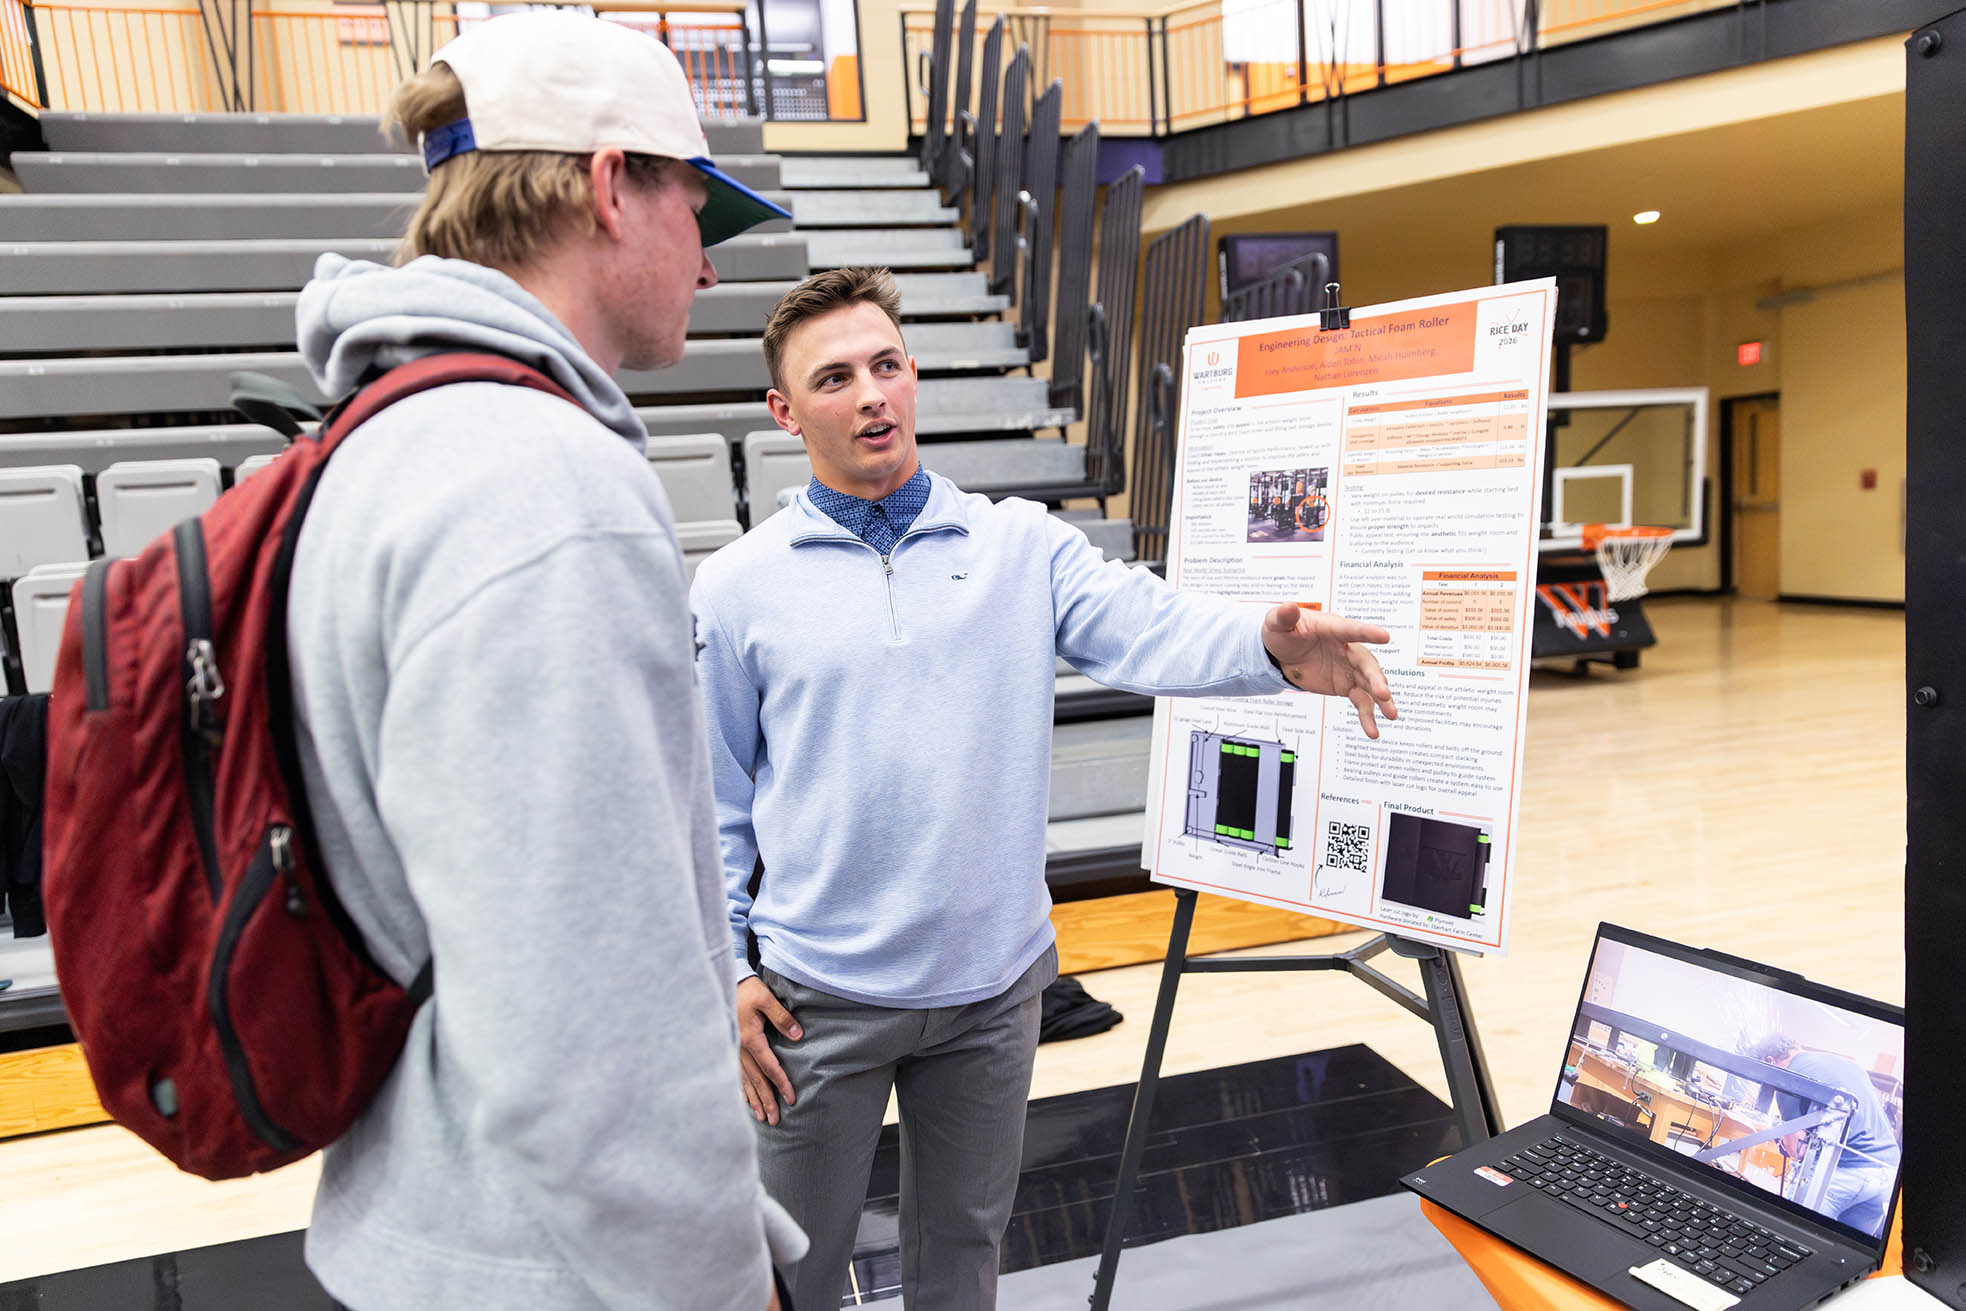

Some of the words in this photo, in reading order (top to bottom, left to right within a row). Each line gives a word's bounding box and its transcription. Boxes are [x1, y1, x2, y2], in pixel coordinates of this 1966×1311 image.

[1258, 335, 1311, 353] Engineering
[1349, 324, 1386, 339] Tactical
[1387, 320, 1416, 333] Foam
[1418, 315, 1449, 329] Roller
[1489, 324, 1508, 336] RICE
[1511, 321, 1529, 333] DAY
[1498, 335, 1517, 346] 2026
[1192, 366, 1233, 380] WARTBURG
[1352, 388, 1378, 398] Results
[1503, 391, 1526, 399] Results
[1191, 407, 1212, 417] Project
[1212, 404, 1241, 414] Overview
[1362, 491, 1380, 499] weight
[1436, 487, 1465, 495] resistance
[1483, 485, 1506, 494] starting
[1467, 529, 1488, 537] weight
[1208, 556, 1243, 564] Description
[1339, 560, 1372, 568] Financial
[1373, 560, 1404, 569] Analysis
[1469, 572, 1498, 580] Analysis
[1403, 690, 1423, 698] Reduce
[1452, 694, 1479, 703] potential
[1479, 696, 1502, 705] injuries
[1435, 718, 1458, 726] facilities
[1472, 722, 1503, 731] encourage
[1344, 742, 1368, 752] Weighted
[1369, 745, 1389, 753] tension
[1389, 747, 1408, 756] system
[1408, 749, 1429, 757] creates
[1429, 752, 1454, 761] compact
[1454, 754, 1478, 764] stacking
[1399, 740, 1415, 748] keeps
[1415, 741, 1433, 749] rollers
[1445, 744, 1460, 752] belts
[1480, 748, 1502, 757] ground
[1357, 752, 1370, 760] body
[1379, 754, 1405, 764] durability
[1411, 758, 1444, 768] unexpected
[1342, 774, 1364, 783] Detailed
[1364, 777, 1379, 785] finish
[1379, 778, 1391, 786] with
[1392, 780, 1405, 788] laser
[1415, 783, 1428, 792] logo
[1437, 786, 1456, 795] overall
[1457, 788, 1477, 798] appeal
[1320, 792, 1359, 804] References
[1383, 800, 1402, 810] Final
[1403, 803, 1434, 814] Product
